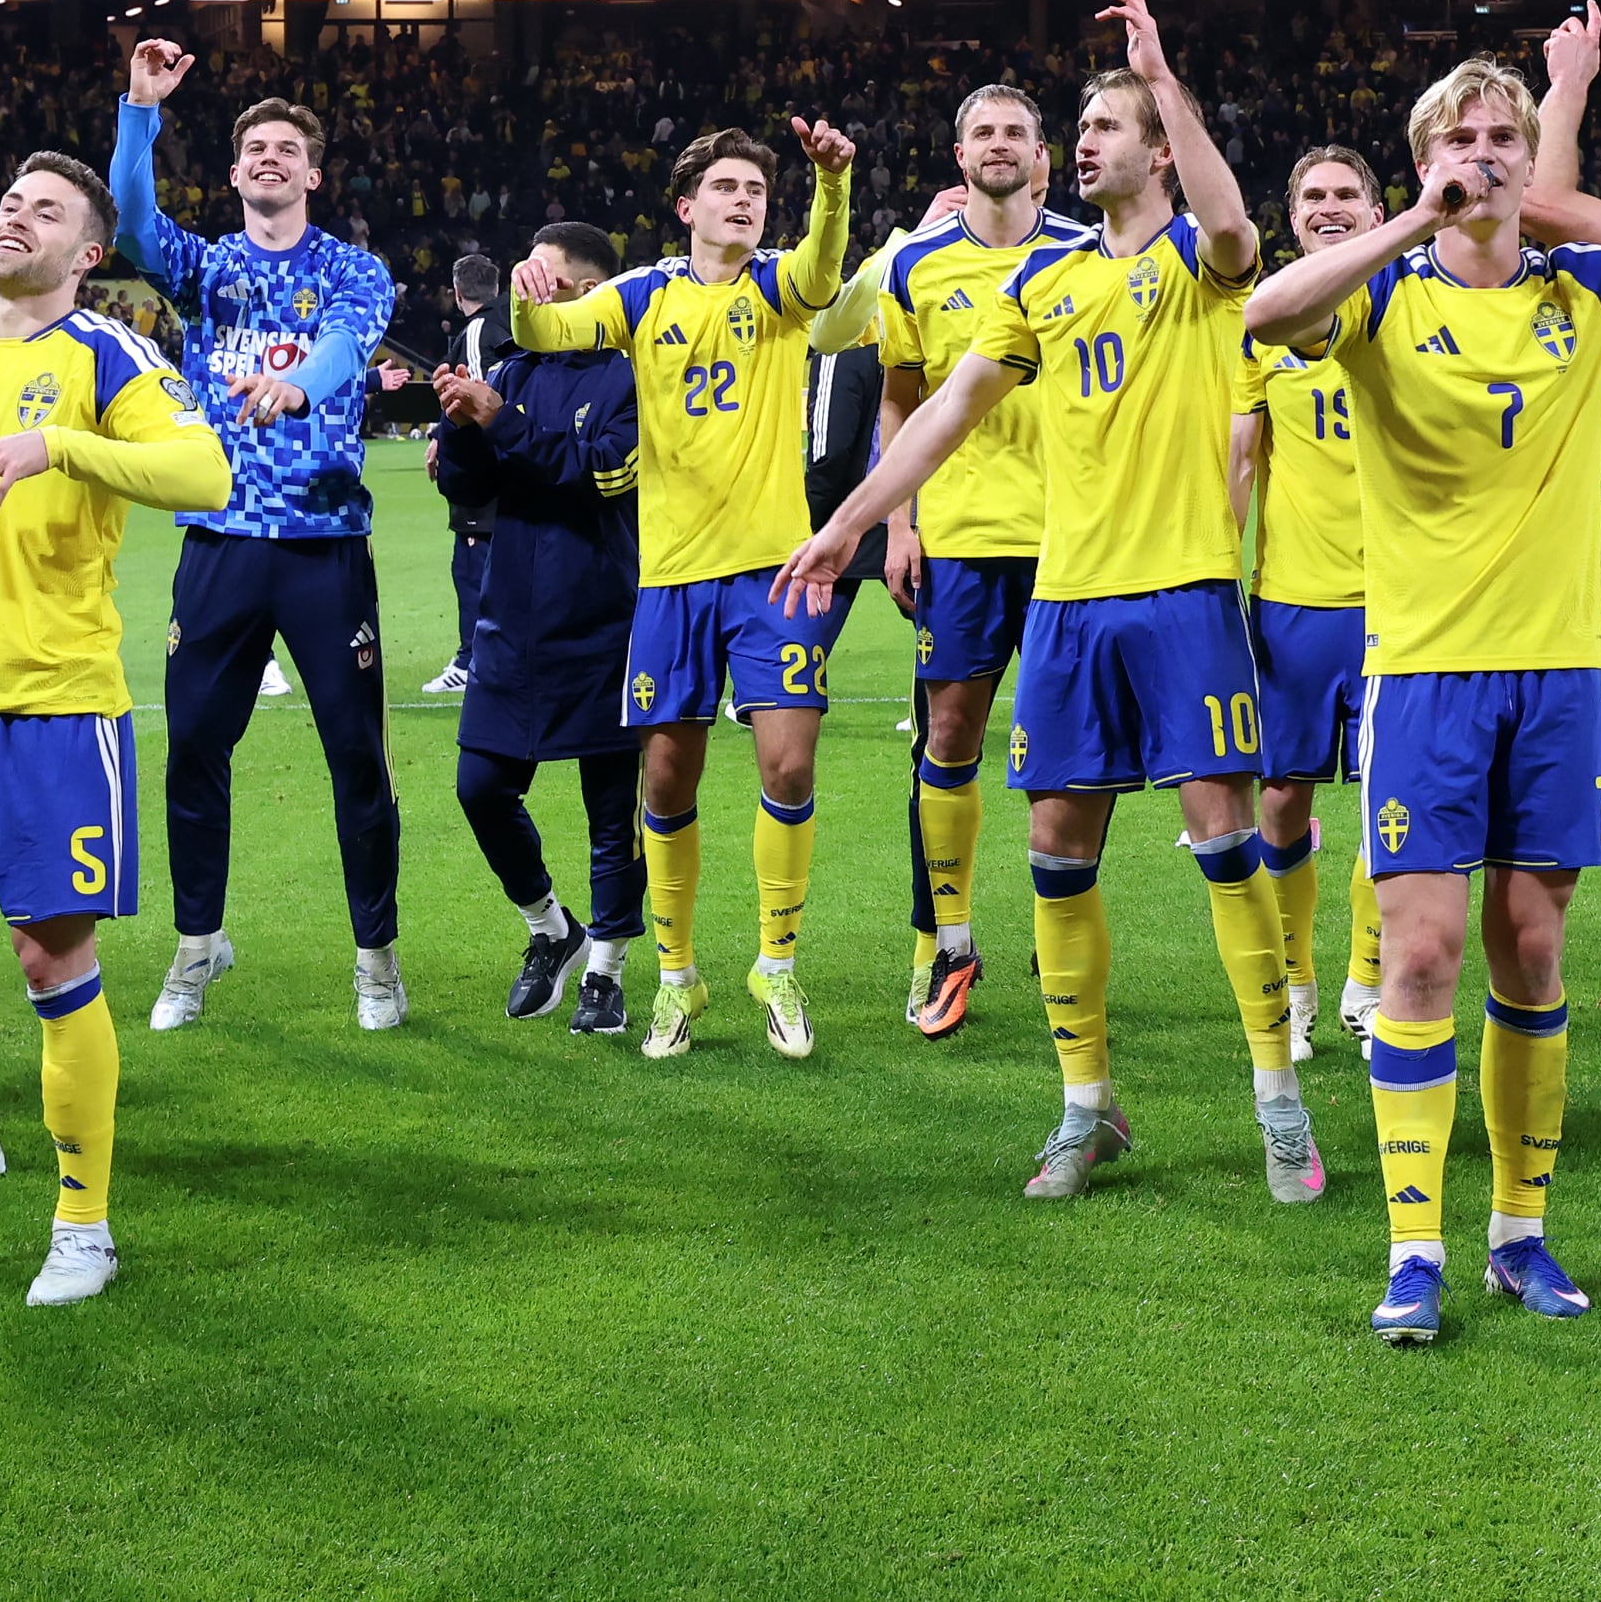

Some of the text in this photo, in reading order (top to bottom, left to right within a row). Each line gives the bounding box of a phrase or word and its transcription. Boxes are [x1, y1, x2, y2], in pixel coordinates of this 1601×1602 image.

[684, 360, 739, 417] 22
[1074, 332, 1124, 398] 10
[1487, 383, 1524, 449] 7
[780, 643, 828, 697] 22
[1204, 692, 1258, 758] 10
[70, 825, 107, 895] 5
[1044, 995, 1079, 1006] ERIGE
